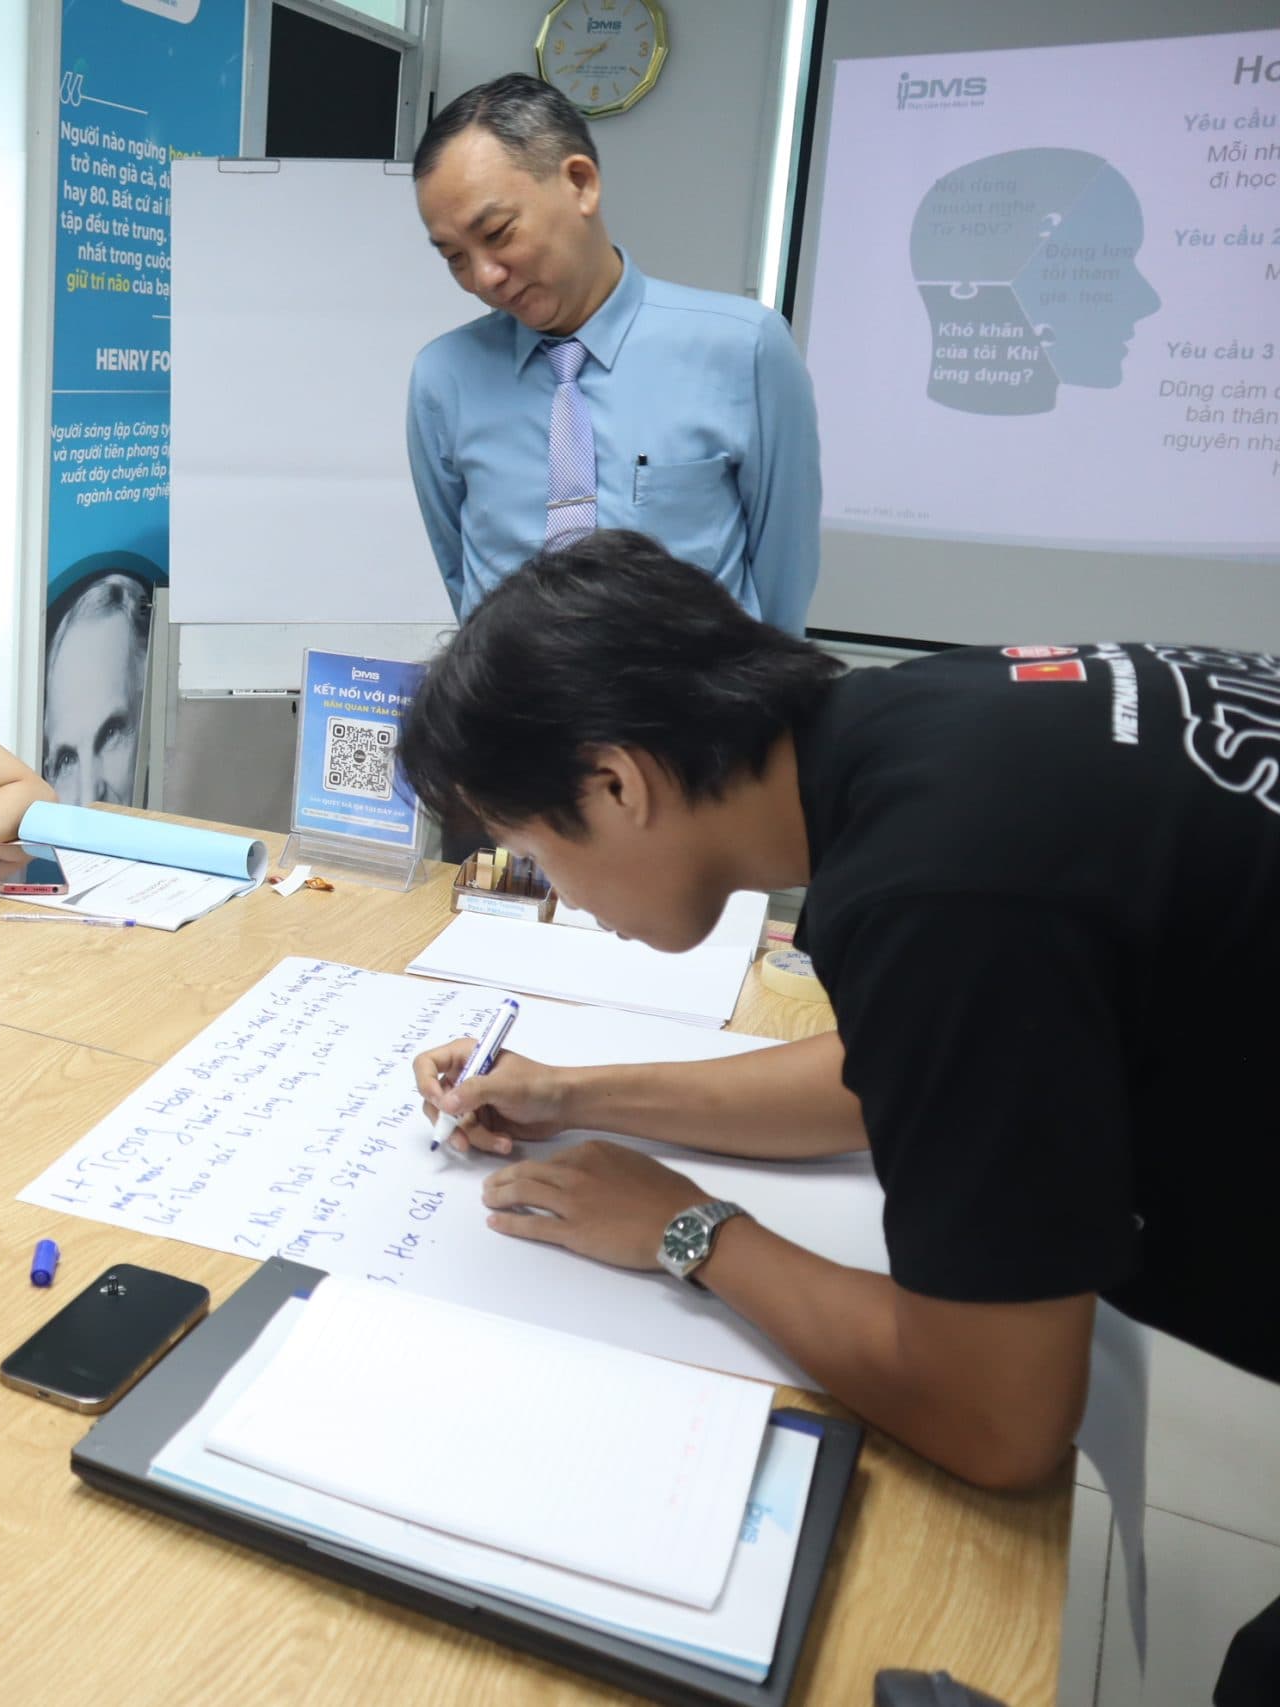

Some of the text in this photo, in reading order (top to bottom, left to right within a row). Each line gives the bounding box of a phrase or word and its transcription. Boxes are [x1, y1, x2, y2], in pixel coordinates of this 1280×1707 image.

[1184, 112, 1226, 132] Yêu
[61, 120, 166, 165] Người nào ngừng
[1208, 138, 1248, 162] Mỗi
[71, 152, 90, 173] trở
[93, 158, 116, 178] nên
[120, 162, 137, 185] già
[1209, 170, 1277, 190] đi học
[64, 180, 87, 206] hay
[90, 186, 109, 206] 80.
[112, 189, 132, 210] Bất
[135, 195, 150, 212] cứ
[152, 197, 162, 215] ai
[61, 210, 82, 235] tập
[132, 222, 167, 246] trung.
[78, 242, 107, 262] nhất
[110, 247, 142, 270] trong
[108, 273, 130, 293] não
[132, 275, 153, 294] của
[156, 278, 171, 301] bạ
[939, 321, 1024, 337] Khó khăn
[96, 348, 149, 371] HENRY
[935, 343, 1040, 361] của tôi Khi
[1168, 341, 1207, 360] Yêu
[974, 367, 1034, 386] dụng?
[1221, 379, 1267, 399] cảm
[1186, 404, 1279, 425] bản thân
[84, 423, 111, 440] sáng
[133, 421, 158, 438] Công
[53, 447, 67, 461] và
[70, 444, 102, 463] người
[126, 442, 159, 461] phong
[1163, 432, 1240, 453] nguyên
[76, 487, 112, 507] ngành
[313, 682, 336, 696] KẾT
[339, 686, 360, 700] NỐI
[363, 690, 385, 703] VỚI
